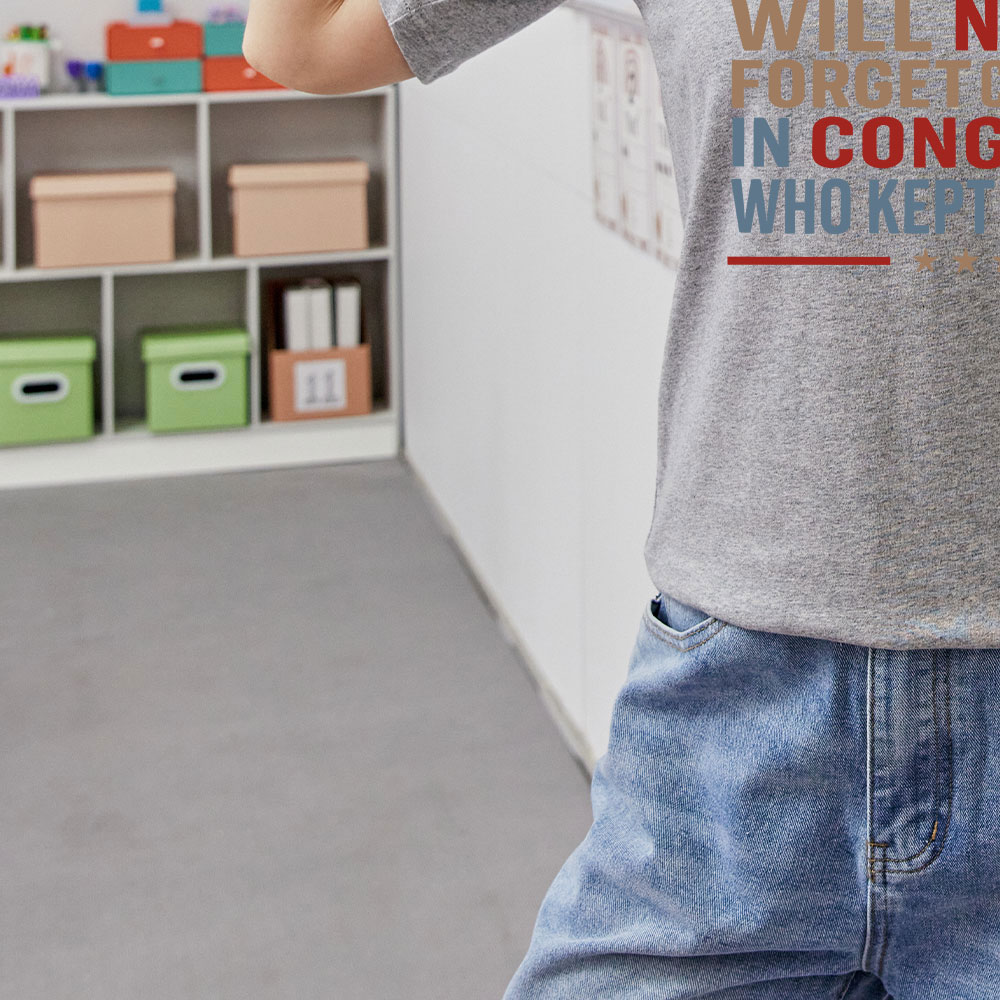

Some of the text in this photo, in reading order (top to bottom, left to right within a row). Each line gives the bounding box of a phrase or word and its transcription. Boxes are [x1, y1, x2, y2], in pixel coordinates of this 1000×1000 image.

[730, 59, 971, 109] FORGET
[732, 117, 790, 168] IN
[731, 179, 851, 234] WHO
[869, 179, 996, 234] KEPT
